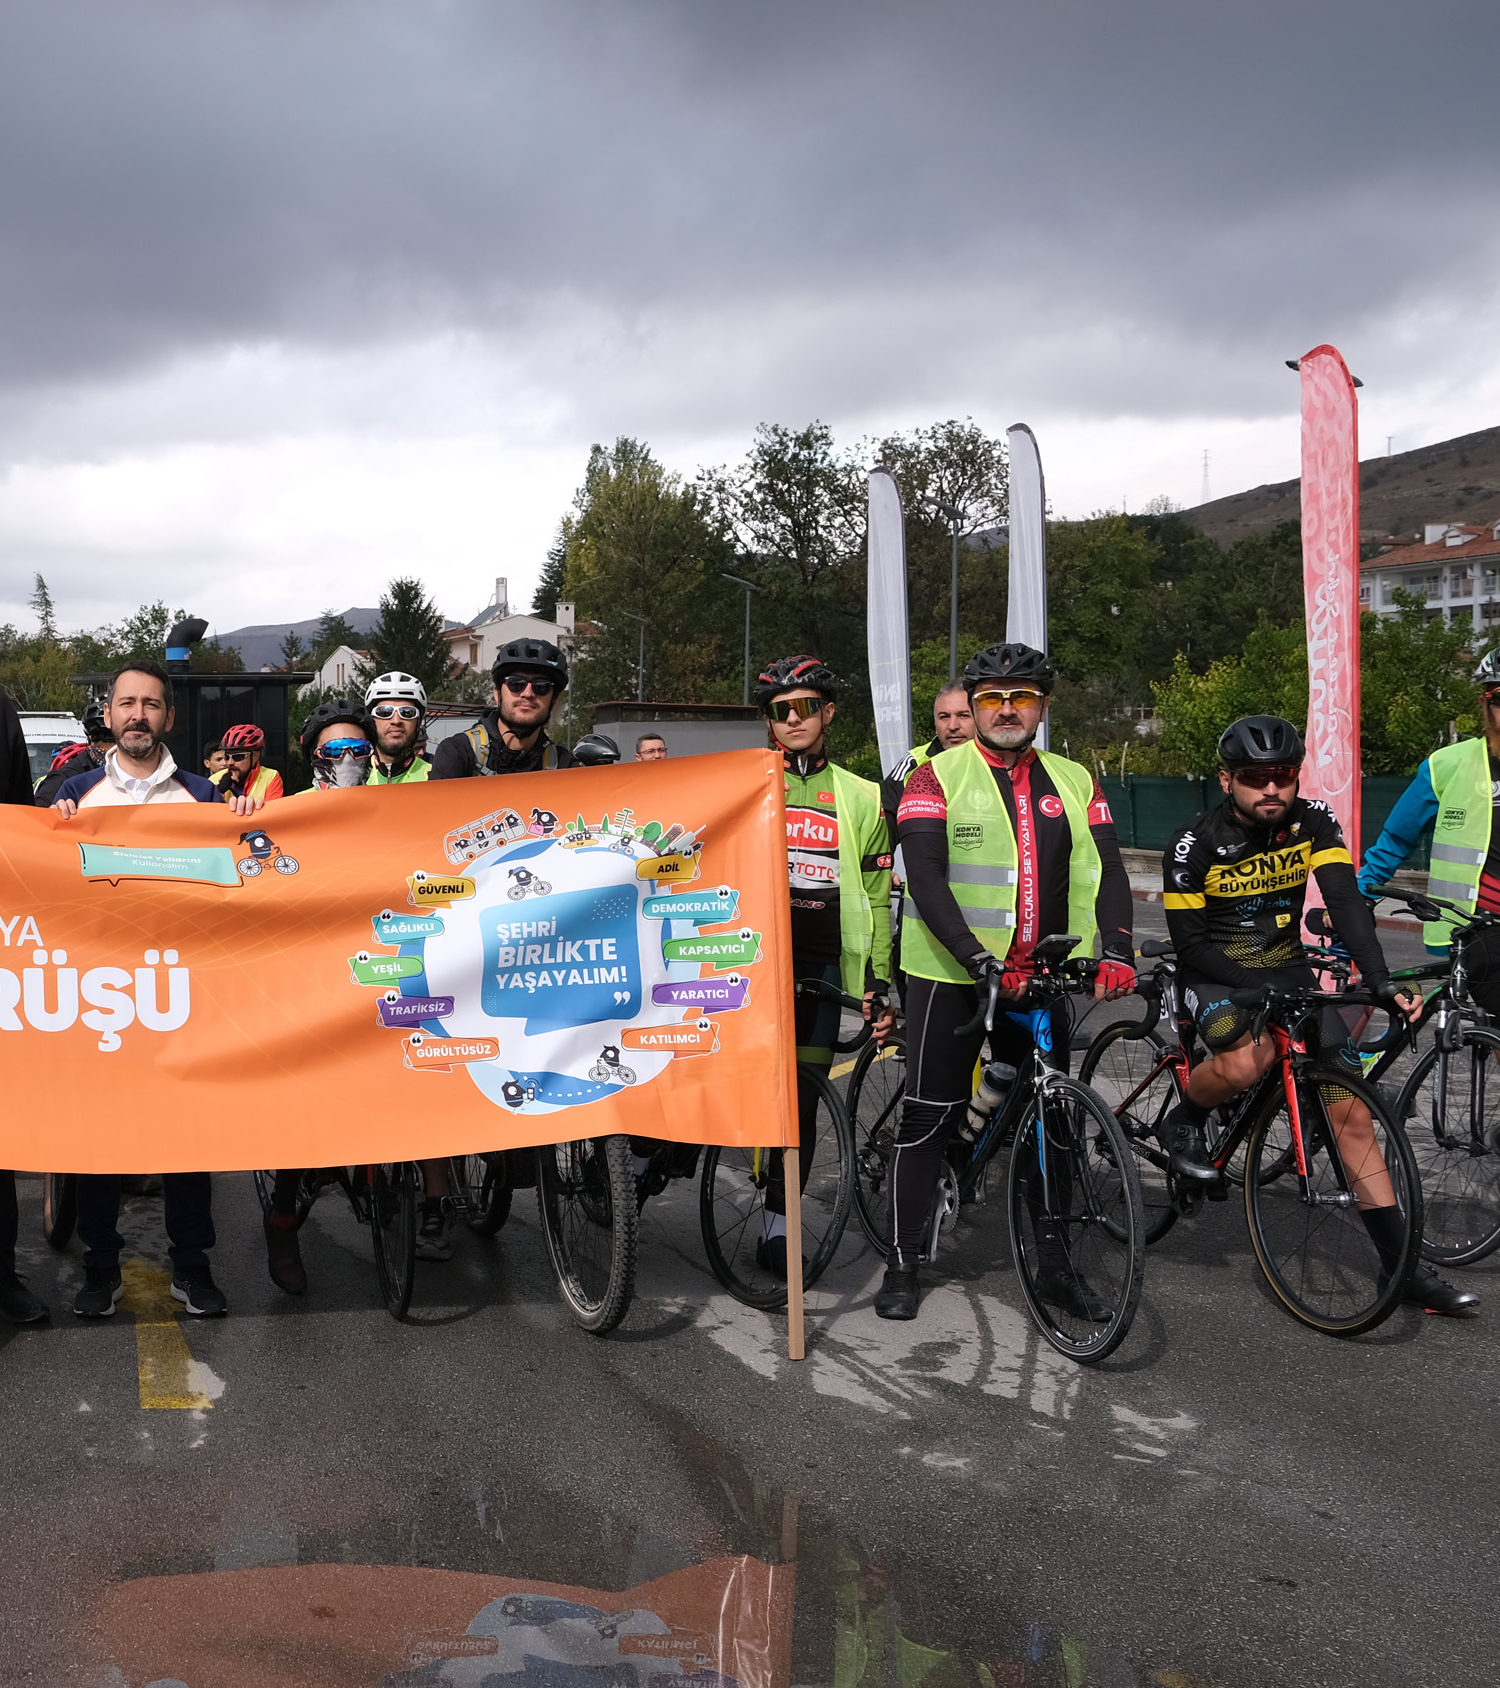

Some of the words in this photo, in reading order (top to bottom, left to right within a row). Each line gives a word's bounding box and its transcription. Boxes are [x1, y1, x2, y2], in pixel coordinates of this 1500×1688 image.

[786, 818, 834, 842] orku
[1018, 794, 1033, 874] SEYYAHLARI
[656, 861, 681, 875] ADİL
[418, 881, 465, 896] GÜVENLİ
[1219, 868, 1306, 894] BÜYÜKŞEHİR
[651, 897, 730, 914] DEMOKRATİK
[1022, 878, 1036, 942] SELÇUKLU
[382, 921, 435, 935] SAĞLIKLI
[496, 916, 557, 942] ŞEHRİ
[498, 936, 618, 968] BİRLİKTE
[678, 943, 746, 956] KAPSAYICI
[371, 961, 404, 977] YEŞİL
[496, 964, 628, 995] YAŞAYALIM!
[670, 988, 730, 1001] YARATICI
[388, 1000, 445, 1017] TRAFİKSİZ
[640, 1032, 700, 1046] KATILIMCI
[416, 1042, 492, 1058] GÜRÜLTÜSÜZ
